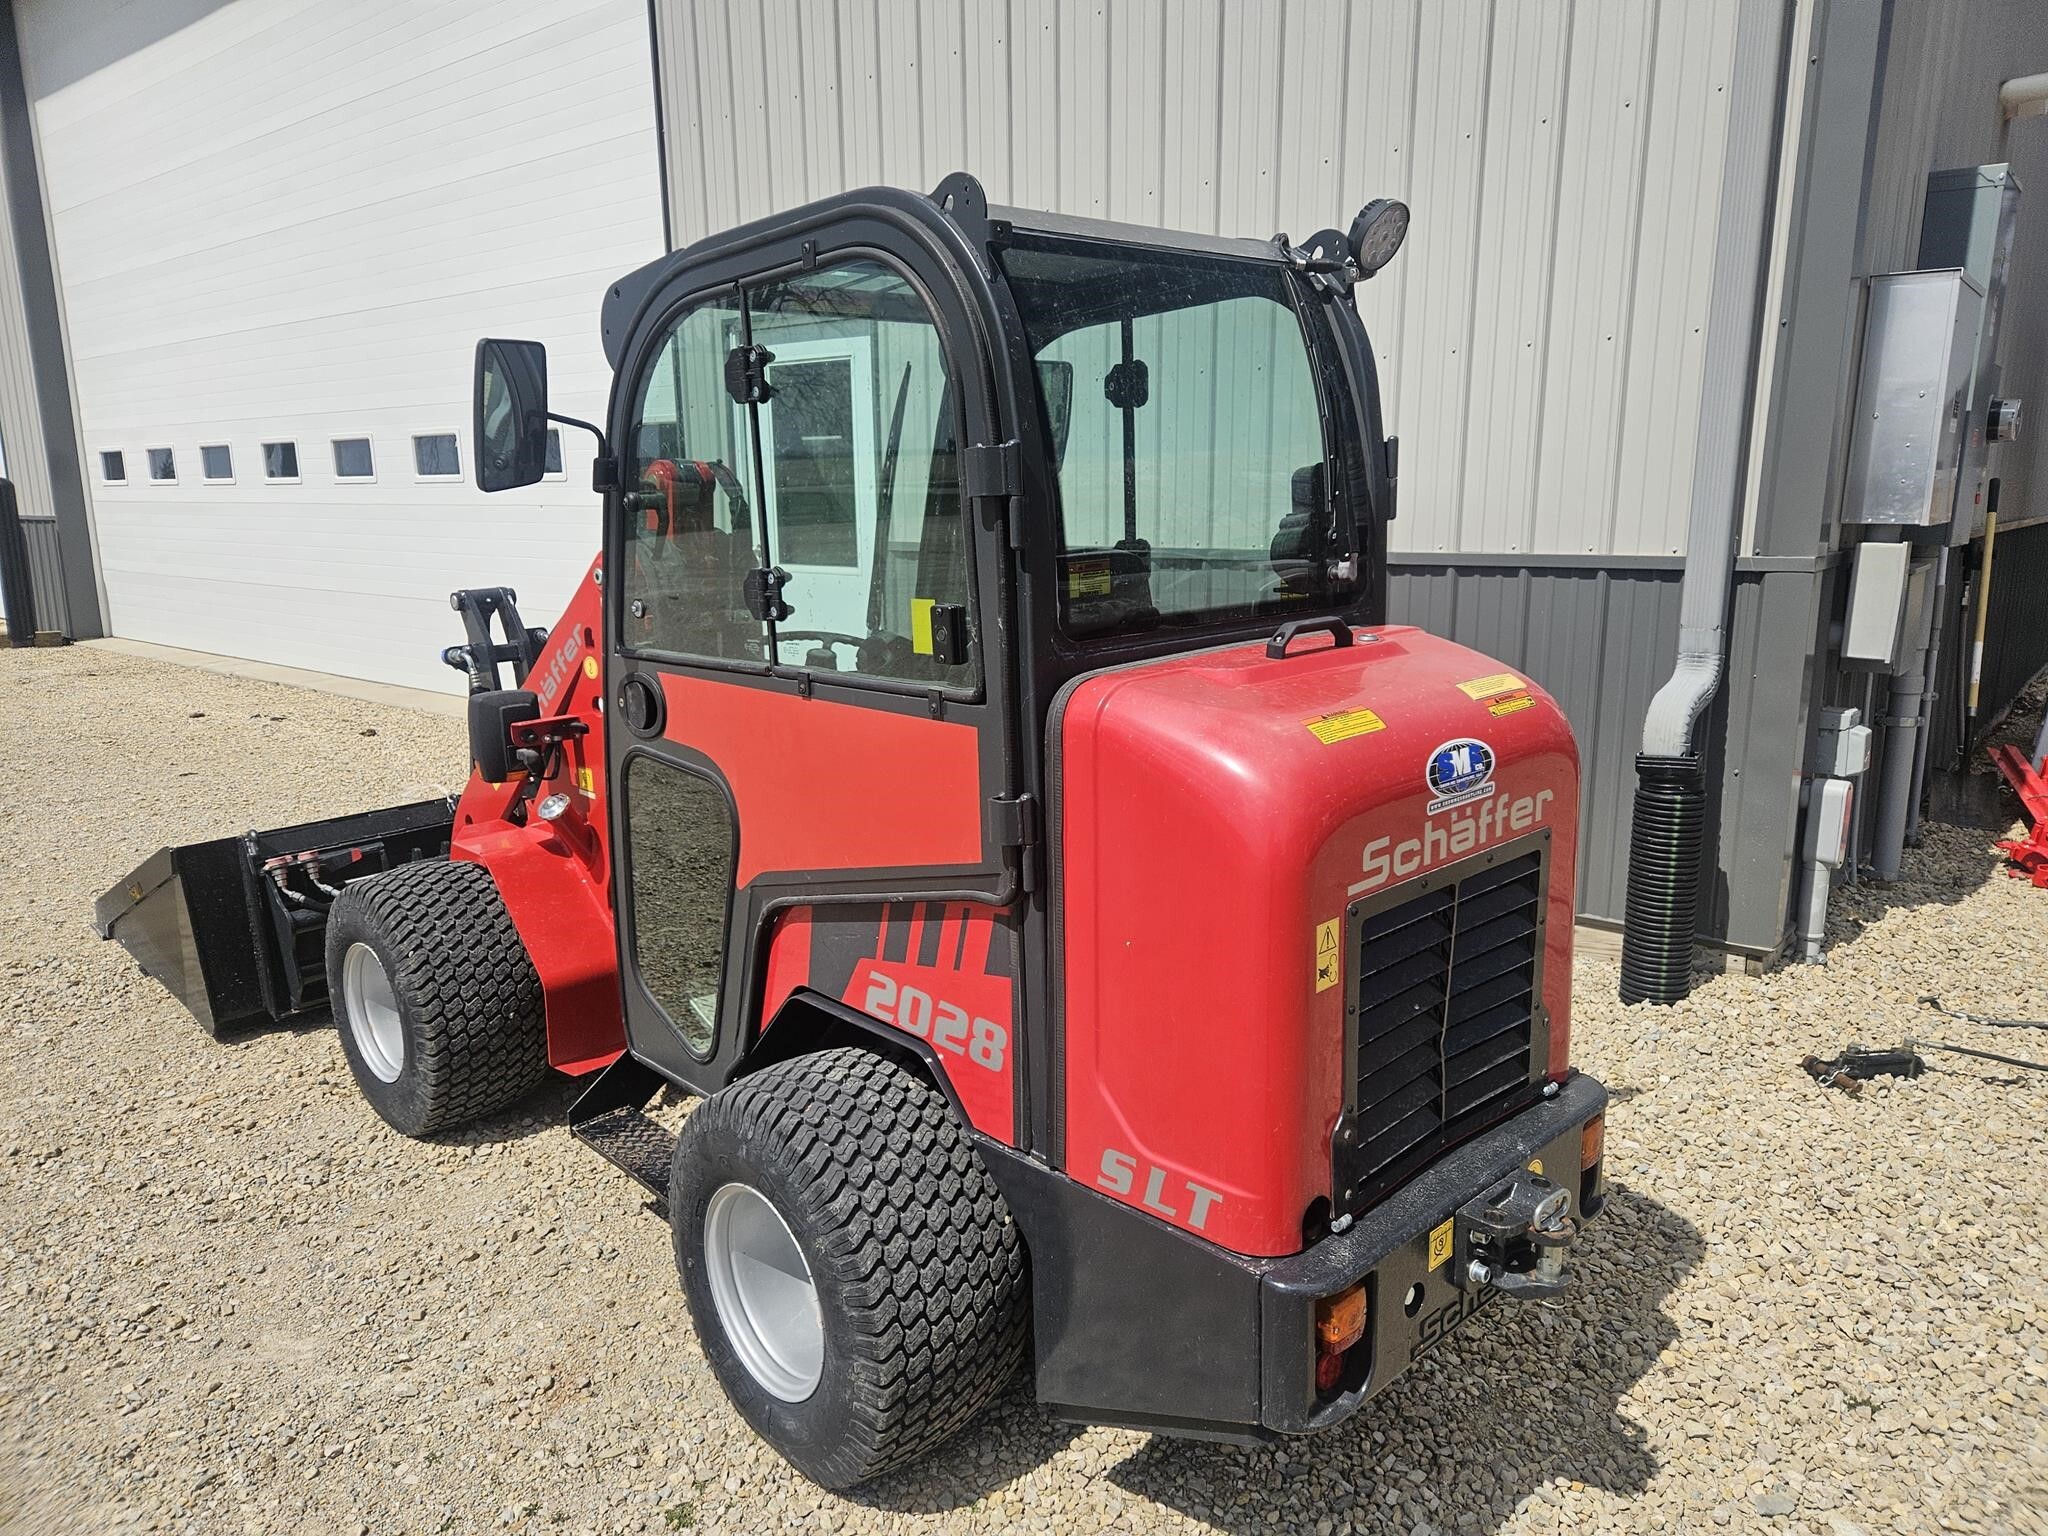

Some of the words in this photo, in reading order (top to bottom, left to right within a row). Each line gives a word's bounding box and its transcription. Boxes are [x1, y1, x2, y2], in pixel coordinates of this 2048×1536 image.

[538, 623, 583, 708] äffer
[1347, 788, 1553, 896] Schäffer
[864, 970, 1008, 1073] 2028
[1097, 1148, 1223, 1230] SLT
